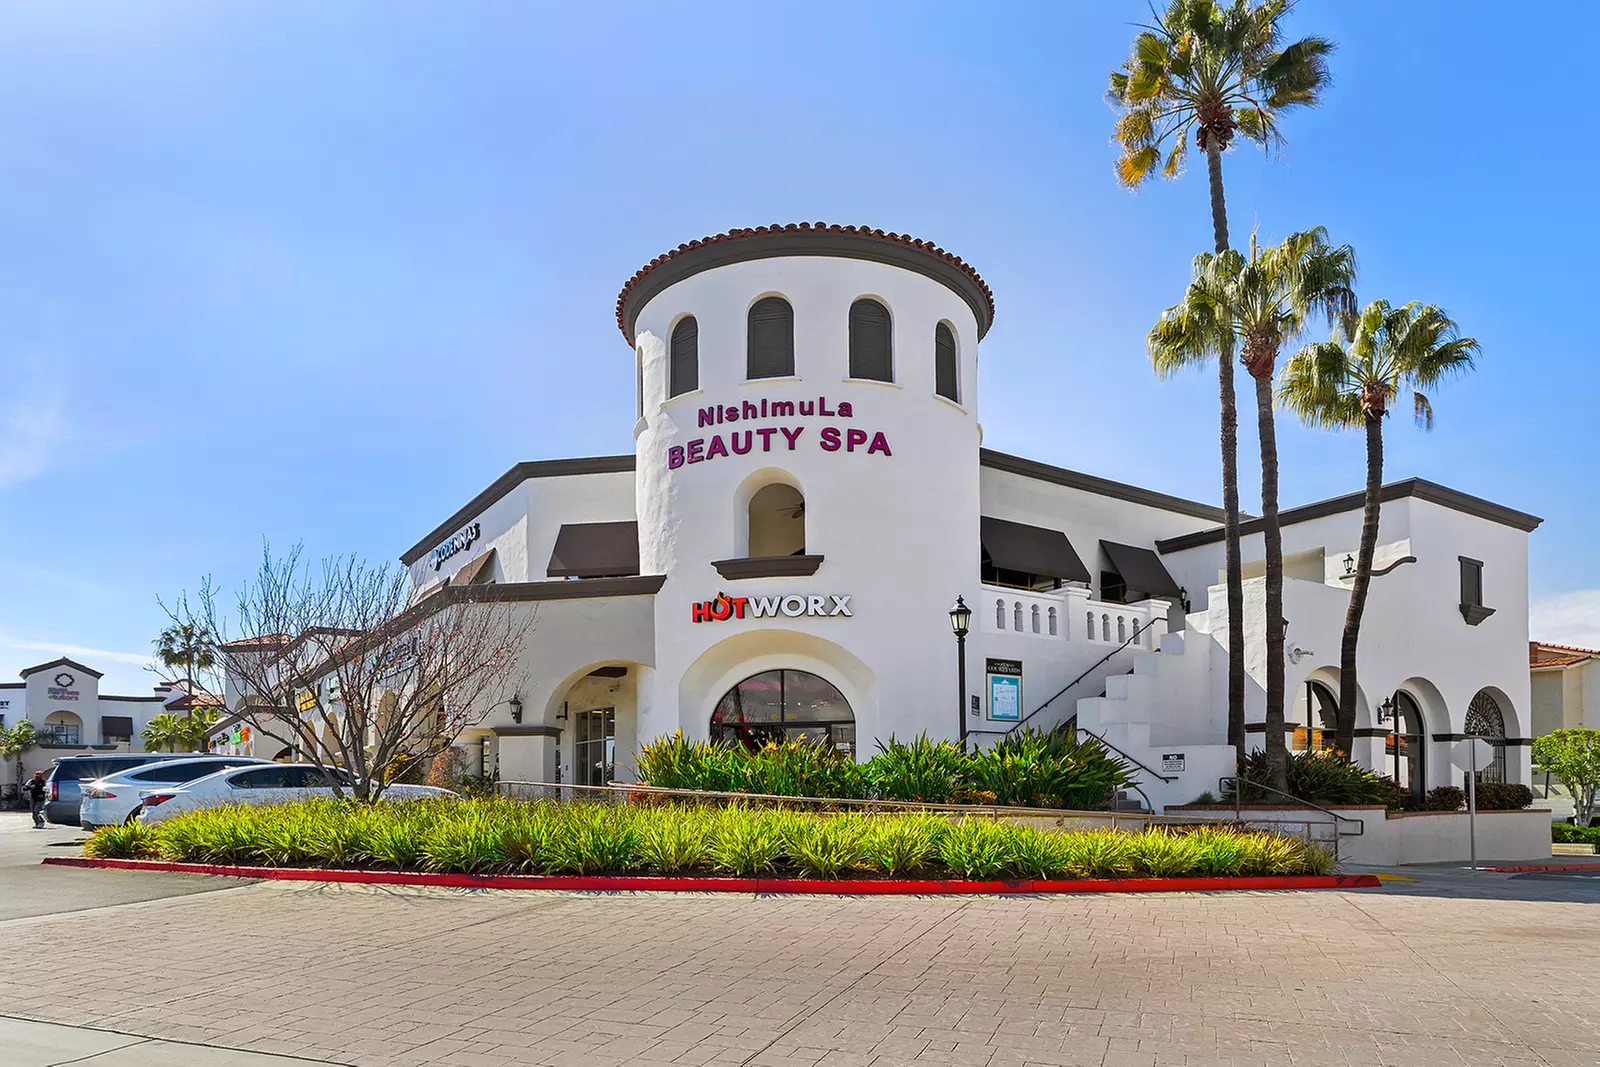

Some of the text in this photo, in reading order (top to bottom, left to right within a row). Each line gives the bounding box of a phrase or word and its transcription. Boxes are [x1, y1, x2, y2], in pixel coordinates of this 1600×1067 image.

[698, 397, 853, 427] NishimuLa
[668, 427, 892, 470] BEAUTY SPA
[692, 592, 853, 623] HOTWORX
